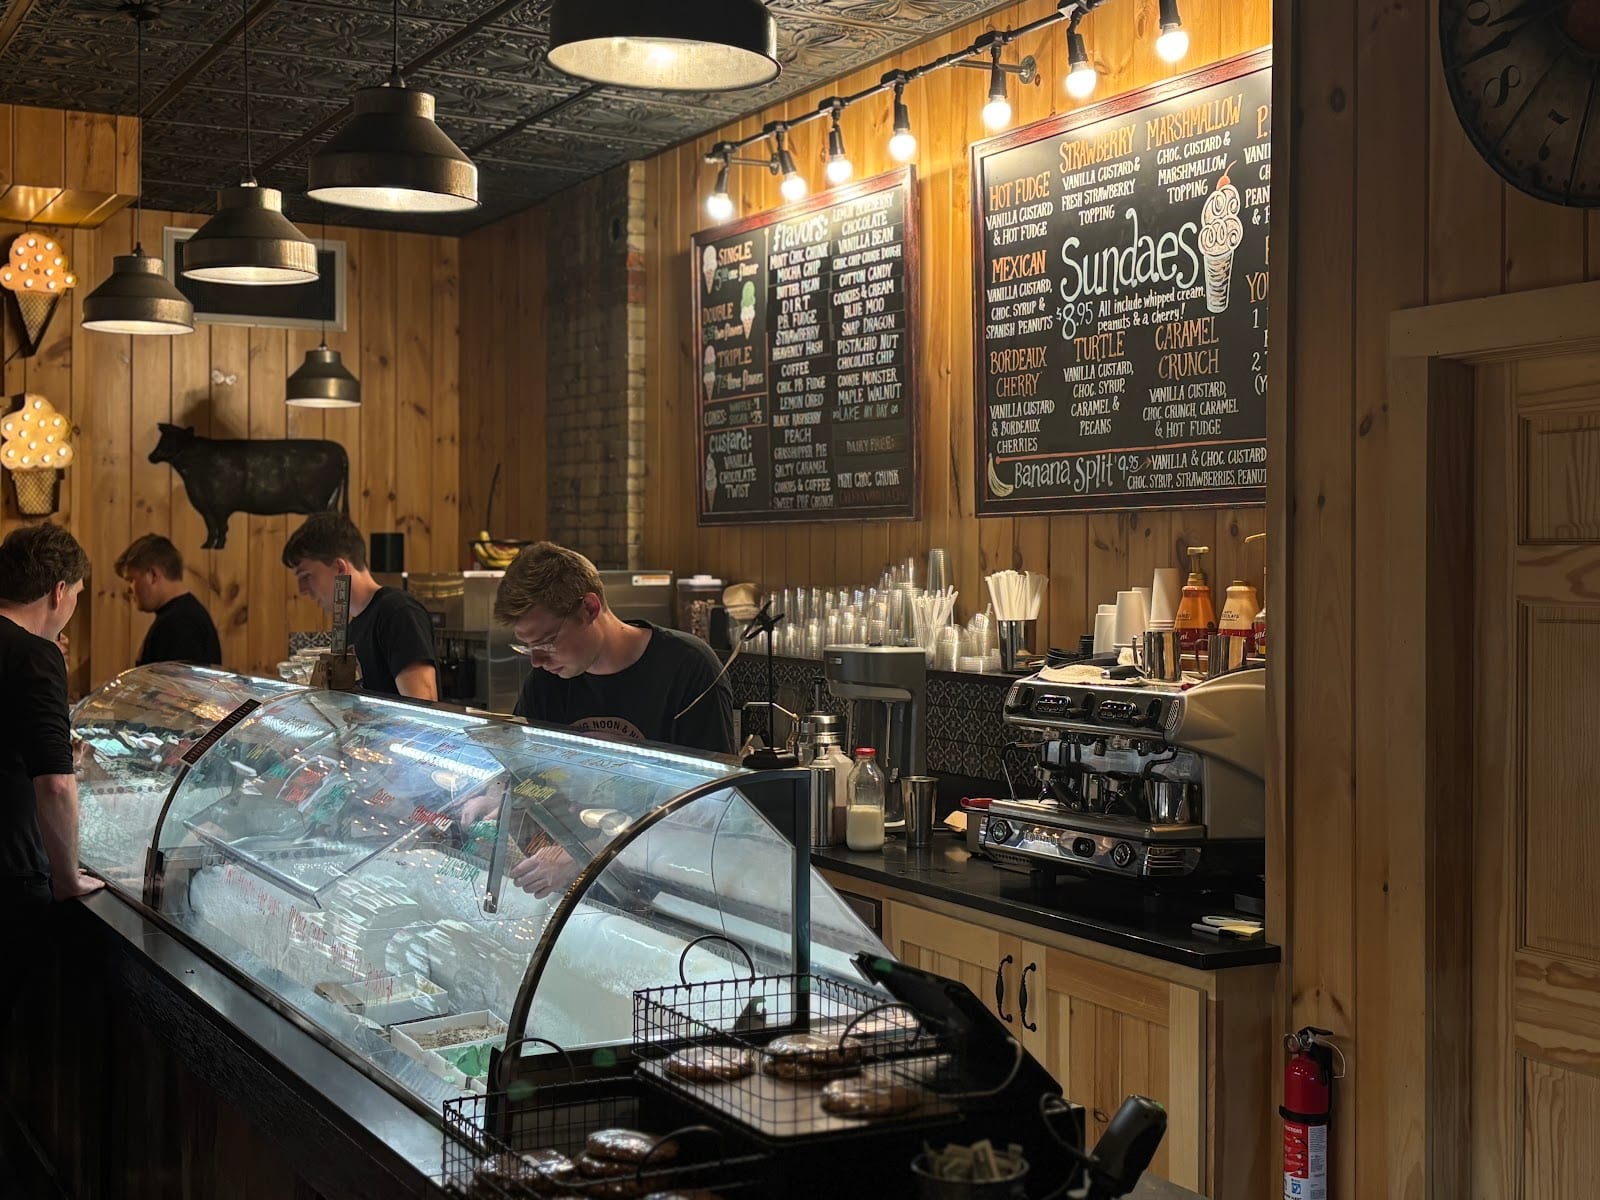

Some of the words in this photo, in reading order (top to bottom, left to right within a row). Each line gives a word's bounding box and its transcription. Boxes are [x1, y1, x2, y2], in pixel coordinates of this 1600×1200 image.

[1146, 94, 1242, 151] MARSHMALLOW
[1060, 124, 1136, 174] STRAWBERRY
[1156, 146, 1182, 165] CHOC.
[1184, 135, 1222, 158] CUSTARD
[1223, 130, 1231, 146] &
[1062, 170, 1096, 190] VANILLA
[1098, 160, 1134, 182] CUSTARD
[1134, 156, 1140, 172] &
[1158, 153, 1228, 186] MARSHMALLOW
[989, 182, 1013, 211] HOT
[1016, 171, 1050, 205] FUDGE
[1061, 192, 1082, 212] FRESH
[1084, 179, 1136, 205] STRAWBERRY
[1167, 178, 1208, 204] TOPPING
[842, 210, 888, 236] CHOCOLATE
[986, 210, 1018, 230] VANILLA
[1019, 202, 1054, 222] CUSTARD
[1079, 204, 1115, 226] TOPPING
[1252, 208, 1261, 225] &
[773, 214, 828, 252] flavors:
[838, 232, 870, 254] VANILLA
[872, 226, 894, 246] BEAN
[993, 230, 1001, 246] &
[1002, 227, 1020, 245] HOT
[1020, 221, 1048, 240] FUDGE
[718, 241, 753, 266] SINGLE
[881, 244, 902, 260] DOUGH
[1060, 207, 1199, 302] Sundaes
[777, 265, 802, 283] MOCHA
[803, 260, 821, 277] CHIP
[839, 269, 866, 287] COTTON
[868, 262, 892, 281] CANDY
[992, 250, 1047, 284] MEXICAN
[833, 288, 860, 306] COOKIES
[861, 284, 868, 298] &
[868, 280, 894, 298] CREAM
[987, 284, 1018, 302] VANILLA
[1019, 278, 1052, 297] CUSTARD,
[782, 294, 810, 314] DIRT
[844, 302, 863, 319] BLUE
[866, 298, 884, 314] MOO
[991, 306, 1011, 320] CHOC.
[1013, 300, 1036, 316] SYRUP
[1039, 296, 1046, 311] &
[1098, 300, 1111, 318] All
[1114, 293, 1142, 314] include
[1144, 286, 1175, 311] whipped
[792, 309, 817, 327] FUDGE
[842, 320, 860, 336] SNAP
[863, 314, 894, 334] DRAGON
[986, 322, 1016, 339] SPANISH
[1018, 316, 1053, 335] PEANUTS
[1056, 301, 1094, 340] $8.95
[1098, 315, 1130, 334] peanuts
[1133, 312, 1142, 326] &
[1152, 302, 1186, 324] cherry!
[776, 325, 820, 346] STRAWBERRY
[838, 336, 878, 355] PISTACHIO
[880, 334, 899, 350] NUT
[1155, 316, 1220, 351] CARAMEL
[717, 346, 752, 368] TRIPLE
[806, 340, 824, 356] HASH
[1074, 331, 1126, 362] TURTLE
[781, 361, 810, 377] COFFEE
[837, 353, 875, 370] CHOCOLATE
[876, 350, 894, 365] CHIP
[990, 346, 1048, 374] BORDEAUX
[1158, 348, 1220, 380] CRUNCH
[1251, 351, 1261, 372] 2
[838, 373, 860, 388] COOKIE
[862, 368, 898, 385] MONSTER
[1064, 364, 1096, 382] VANILLA
[1098, 361, 1134, 378] CUSTARD,
[806, 376, 826, 390] FUDGE
[996, 373, 1040, 398] CHERRY
[1073, 383, 1096, 398] CHOC.
[1148, 384, 1184, 403] VANILLA
[1188, 381, 1226, 398] CUSTARD,
[780, 395, 803, 410] LEMON
[804, 393, 824, 408] OREO
[838, 388, 864, 406] MAPLE
[867, 383, 902, 402] WALNUT
[876, 403, 888, 417] DAY
[990, 402, 1022, 420] VANILLA
[1023, 400, 1055, 416] CUSTARD
[1071, 399, 1110, 416] CARAMEL
[1112, 396, 1120, 411] &
[1164, 402, 1197, 418] CRUNCH,
[1200, 398, 1239, 416] CARAMEL
[784, 428, 812, 444] PEACH
[992, 421, 998, 437] &
[1000, 419, 1040, 436] BORDEAUX
[1080, 418, 1112, 436] PECANS
[1155, 420, 1164, 438] &
[1166, 421, 1186, 438] HOT
[1190, 419, 1222, 436] FUDGE
[710, 428, 752, 454] custard:
[816, 443, 828, 458] PIE
[846, 440, 868, 453] DAIRY
[996, 438, 1038, 454] CHERRIES
[724, 452, 754, 470] VANILLA
[775, 463, 794, 478] SALTY
[796, 460, 828, 475] CARAMEL
[1152, 453, 1188, 470] VANILLA
[1190, 449, 1198, 466] &
[1200, 450, 1225, 466] CHOC.
[1228, 447, 1267, 464] CUSTARD
[720, 468, 757, 483] CHOCOLATE
[875, 470, 900, 486] CHUNK
[1014, 460, 1071, 488] Banana
[1074, 453, 1114, 494] Split
[725, 484, 750, 498] TWIST
[798, 478, 804, 492] &
[805, 478, 831, 492] COFFEE
[592, 720, 620, 730] NOON
